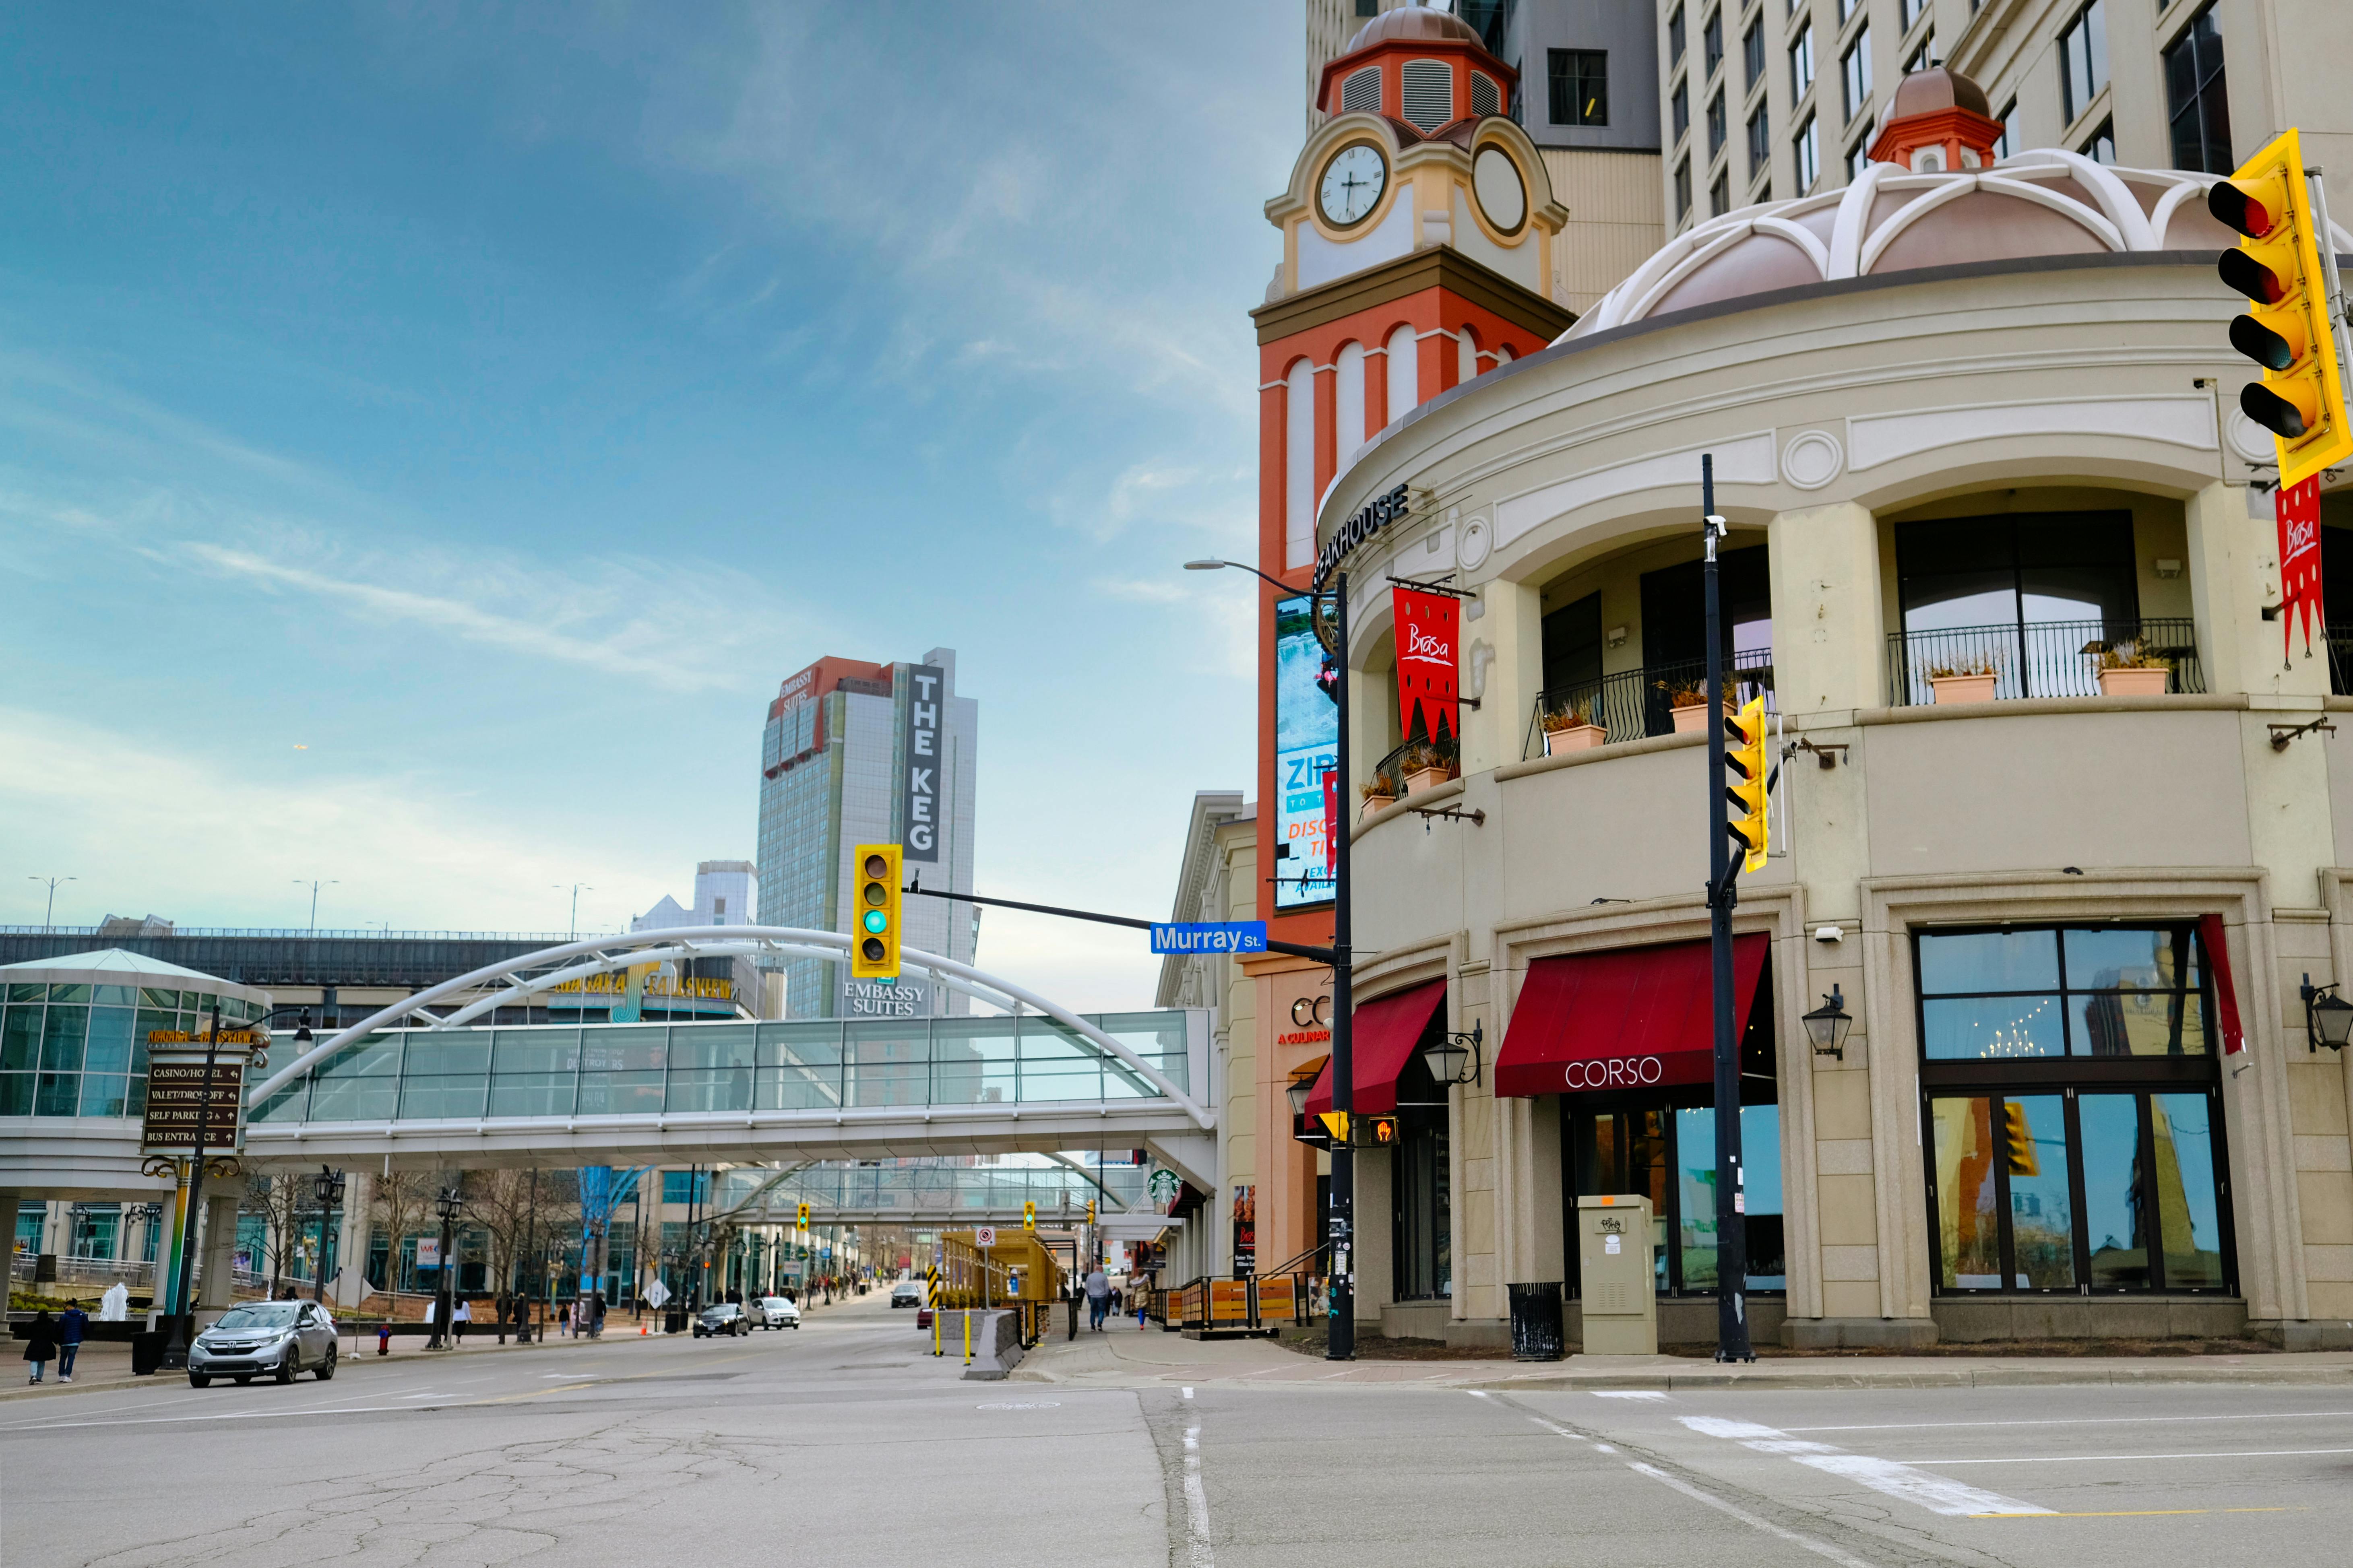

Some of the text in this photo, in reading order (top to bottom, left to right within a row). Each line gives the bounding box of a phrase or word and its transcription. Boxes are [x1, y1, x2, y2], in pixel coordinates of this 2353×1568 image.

[2286, 519, 2313, 555] Brasa
[1408, 623, 1448, 658] Brasa
[781, 669, 812, 699] EMBASSY
[784, 689, 807, 713] SUITES
[910, 675, 937, 851] THE KEG
[1290, 798, 1306, 807] TO
[1156, 927, 1261, 952] Murray St.
[845, 983, 924, 1002] EMBASSY
[853, 999, 914, 1016] SUITES
[200, 1031, 251, 1043] FALSVIEW
[1278, 1030, 1330, 1044] A CULINAR
[154, 1069, 223, 1077] CASINO/HOEL
[1566, 1057, 1661, 1088] CORSO
[149, 1112, 213, 1120] SELF PARKIG
[147, 1133, 216, 1141] BUS ENTRACE
